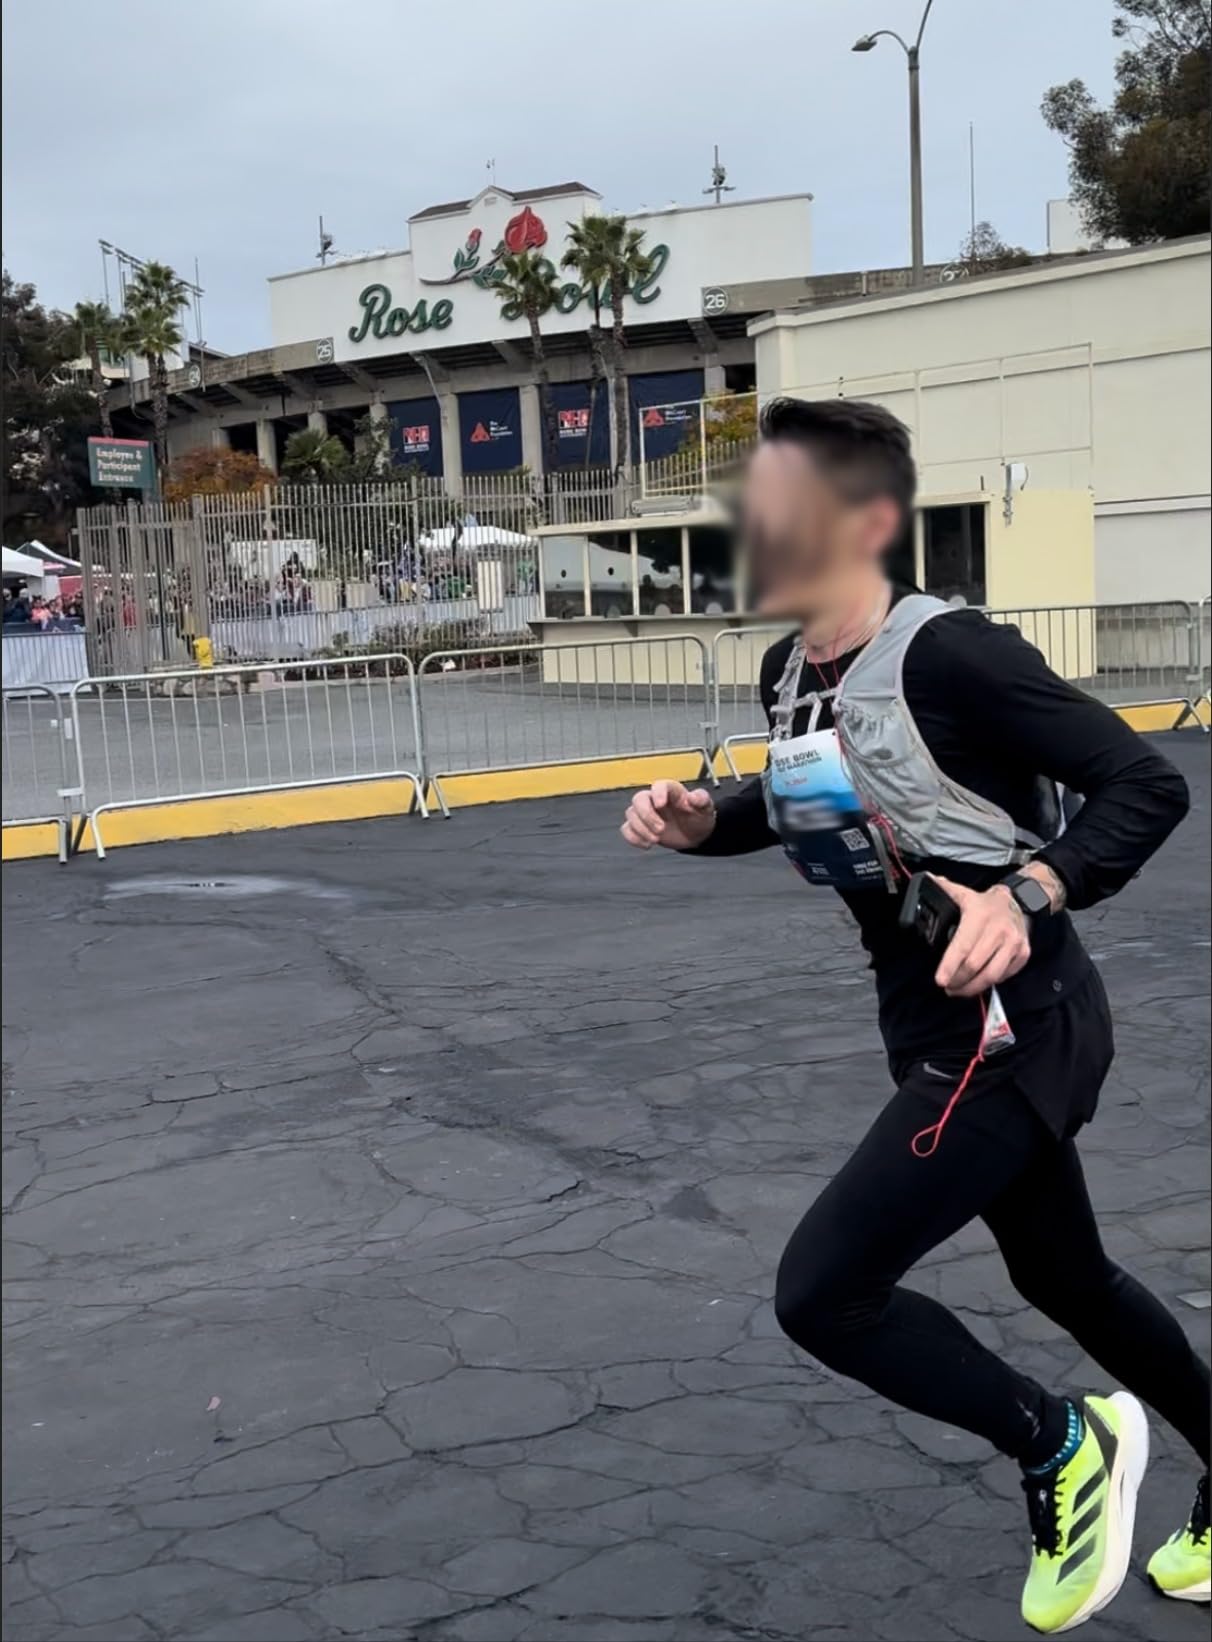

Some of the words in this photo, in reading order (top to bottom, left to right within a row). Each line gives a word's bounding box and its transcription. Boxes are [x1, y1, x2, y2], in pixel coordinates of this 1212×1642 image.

[705, 293, 726, 309] 26
[348, 283, 454, 343] Rose
[793, 749, 820, 761] BOWL
